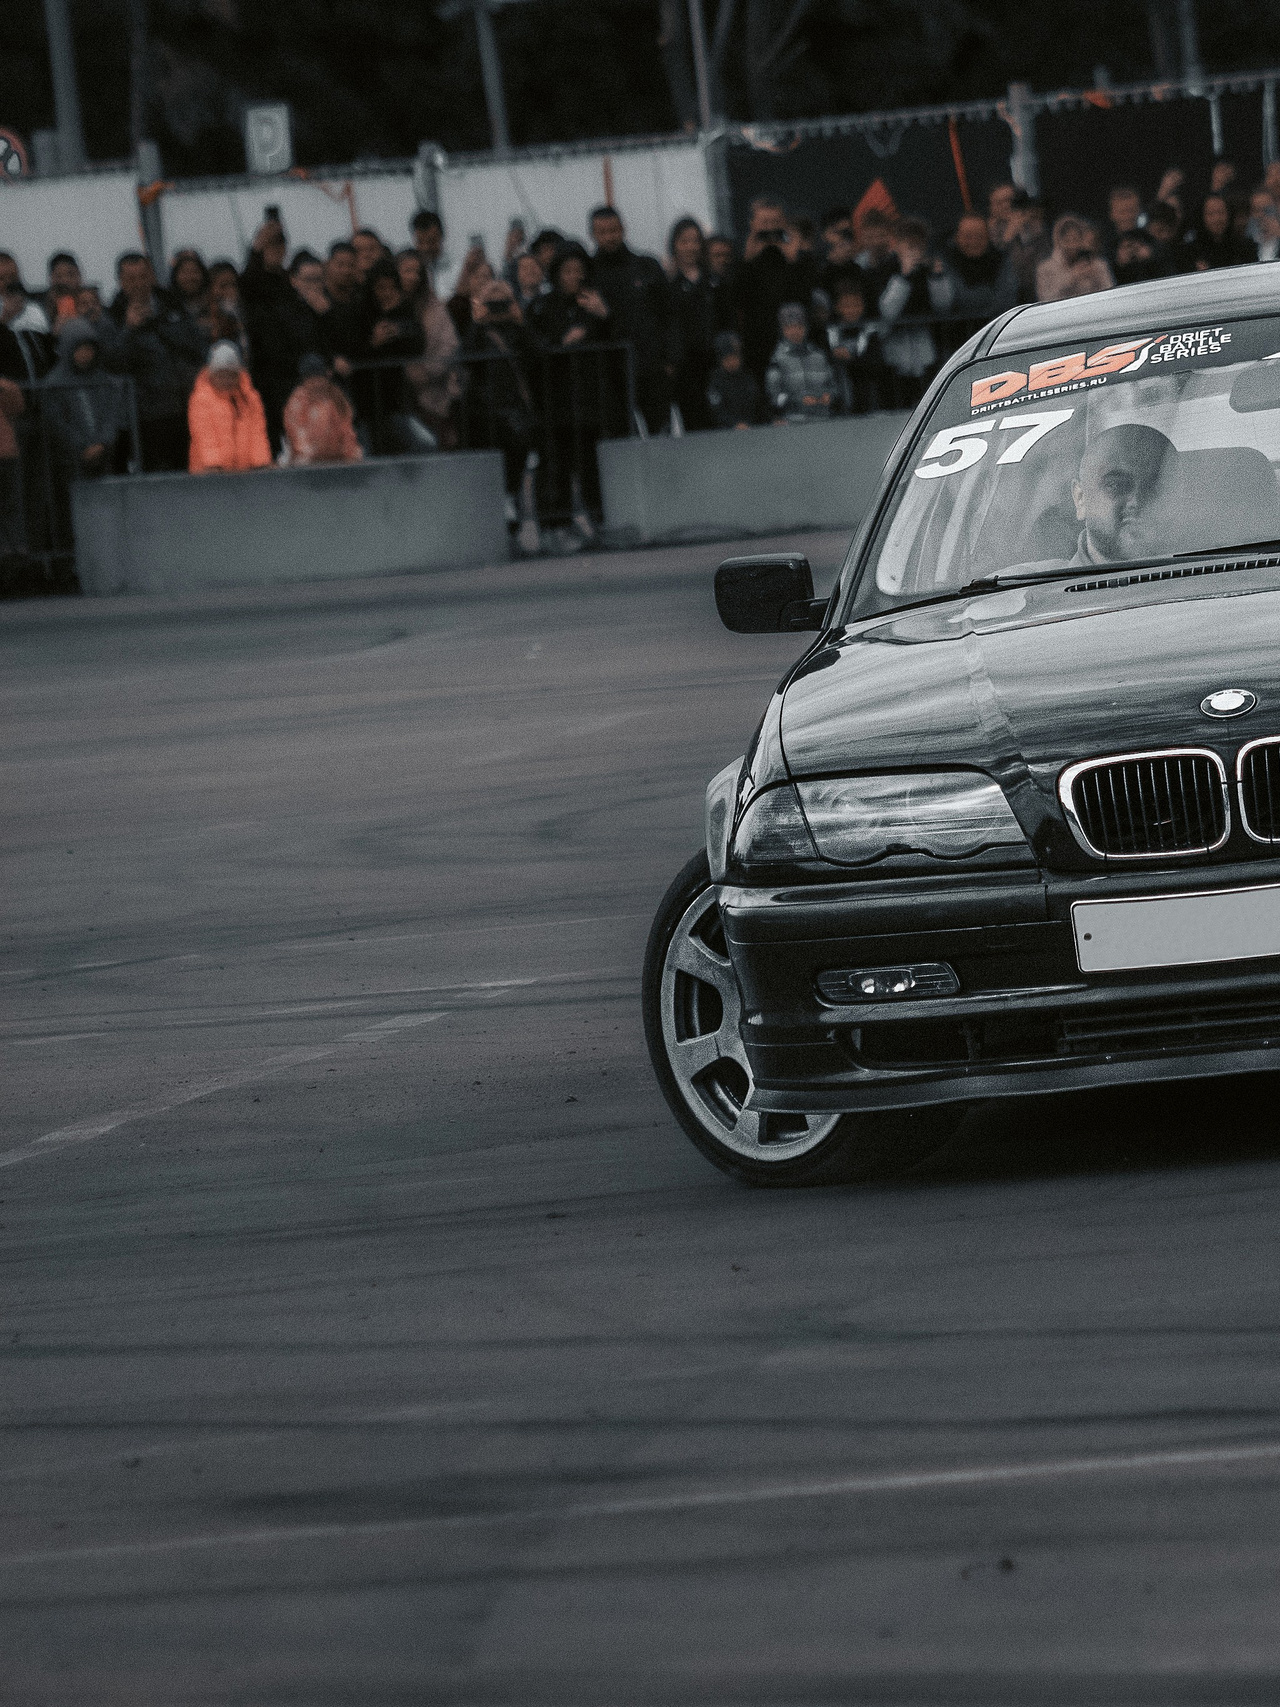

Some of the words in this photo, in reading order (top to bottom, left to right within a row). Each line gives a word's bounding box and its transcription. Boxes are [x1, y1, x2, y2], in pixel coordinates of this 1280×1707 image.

[1160, 333, 1232, 354] BATTLE
[1169, 327, 1223, 345] DRIFT
[1150, 344, 1222, 364] SERIES
[970, 337, 1153, 408] DBS
[971, 377, 1107, 416] DRIFTBATTLESERIES.RU
[914, 408, 1075, 480] 57
